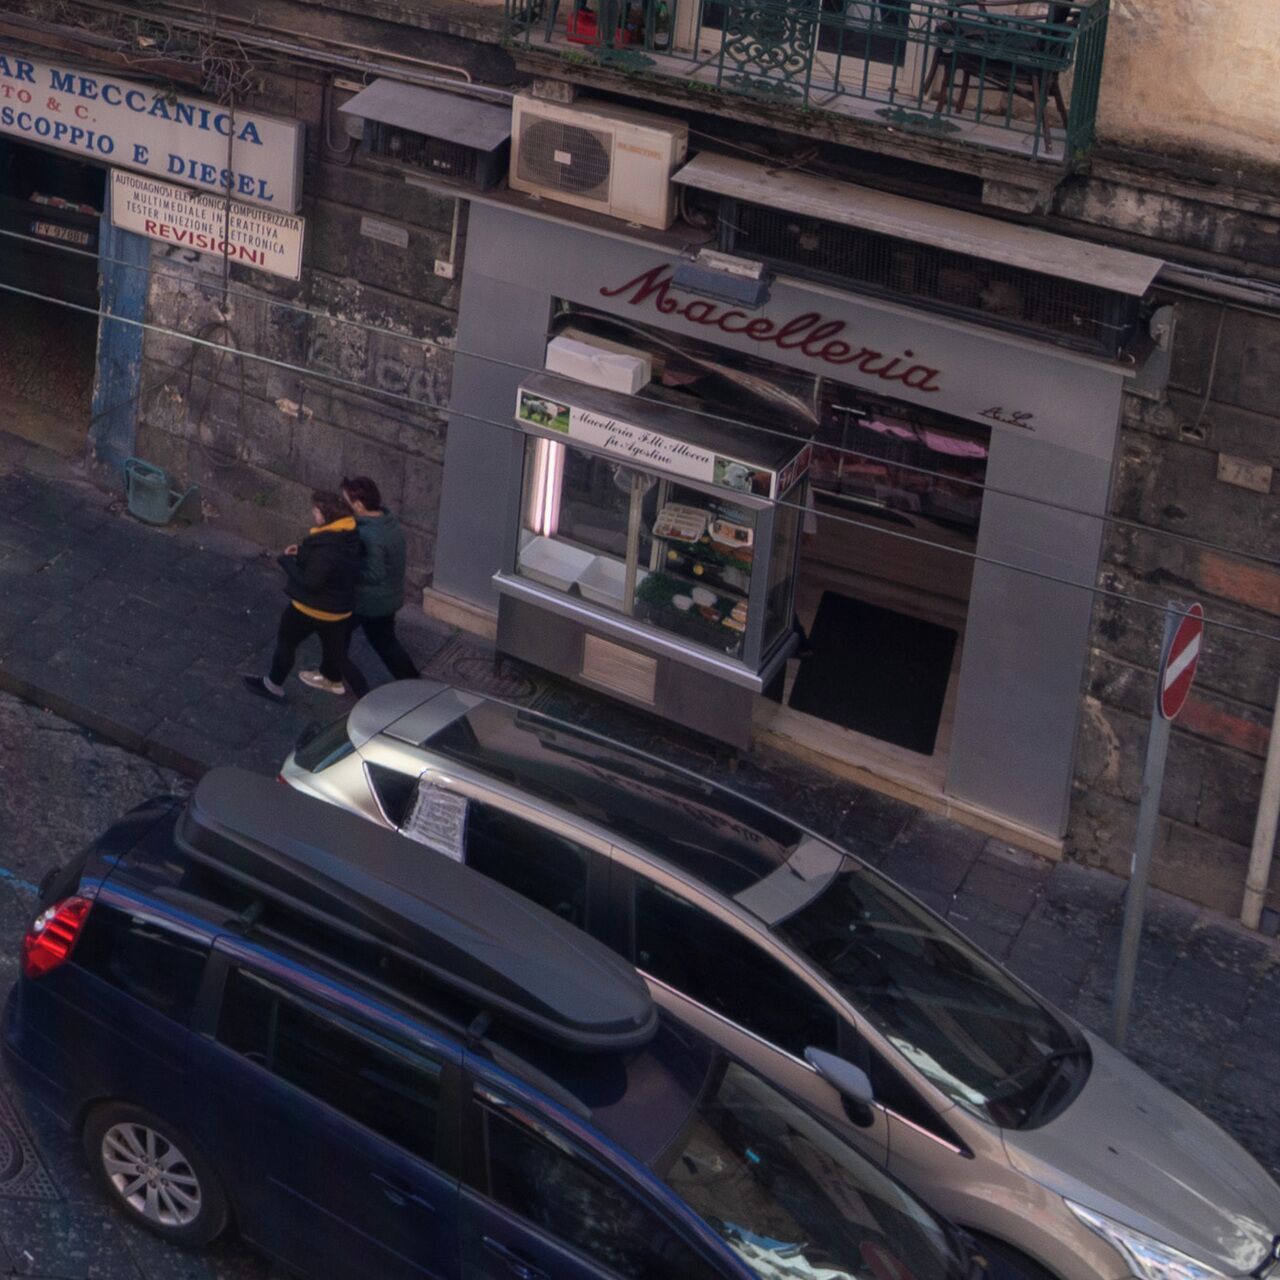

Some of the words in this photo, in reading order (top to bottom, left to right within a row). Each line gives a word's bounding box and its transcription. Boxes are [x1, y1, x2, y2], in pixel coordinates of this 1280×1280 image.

[46, 96, 62, 113] &
[74, 104, 97, 123] C.
[49, 68, 264, 146] MECCANICA
[1, 105, 115, 155] SCOPPIO
[133, 143, 149, 166] E
[168, 153, 274, 203] DIESEL
[115, 173, 173, 198] AUTODIAGNOSI
[229, 201, 300, 232] COMPUTERIZZATA
[127, 201, 159, 219] TESTER
[164, 211, 214, 234] INIEZIONE
[218, 226, 285, 256] EETTRONICA
[132, 191, 207, 219] MULTIMEDIALE
[212, 212, 279, 239] INERATTIVA
[144, 219, 266, 266] REVISIONI
[599, 263, 941, 394] Macelleria
[572, 411, 635, 440] Macelleria
